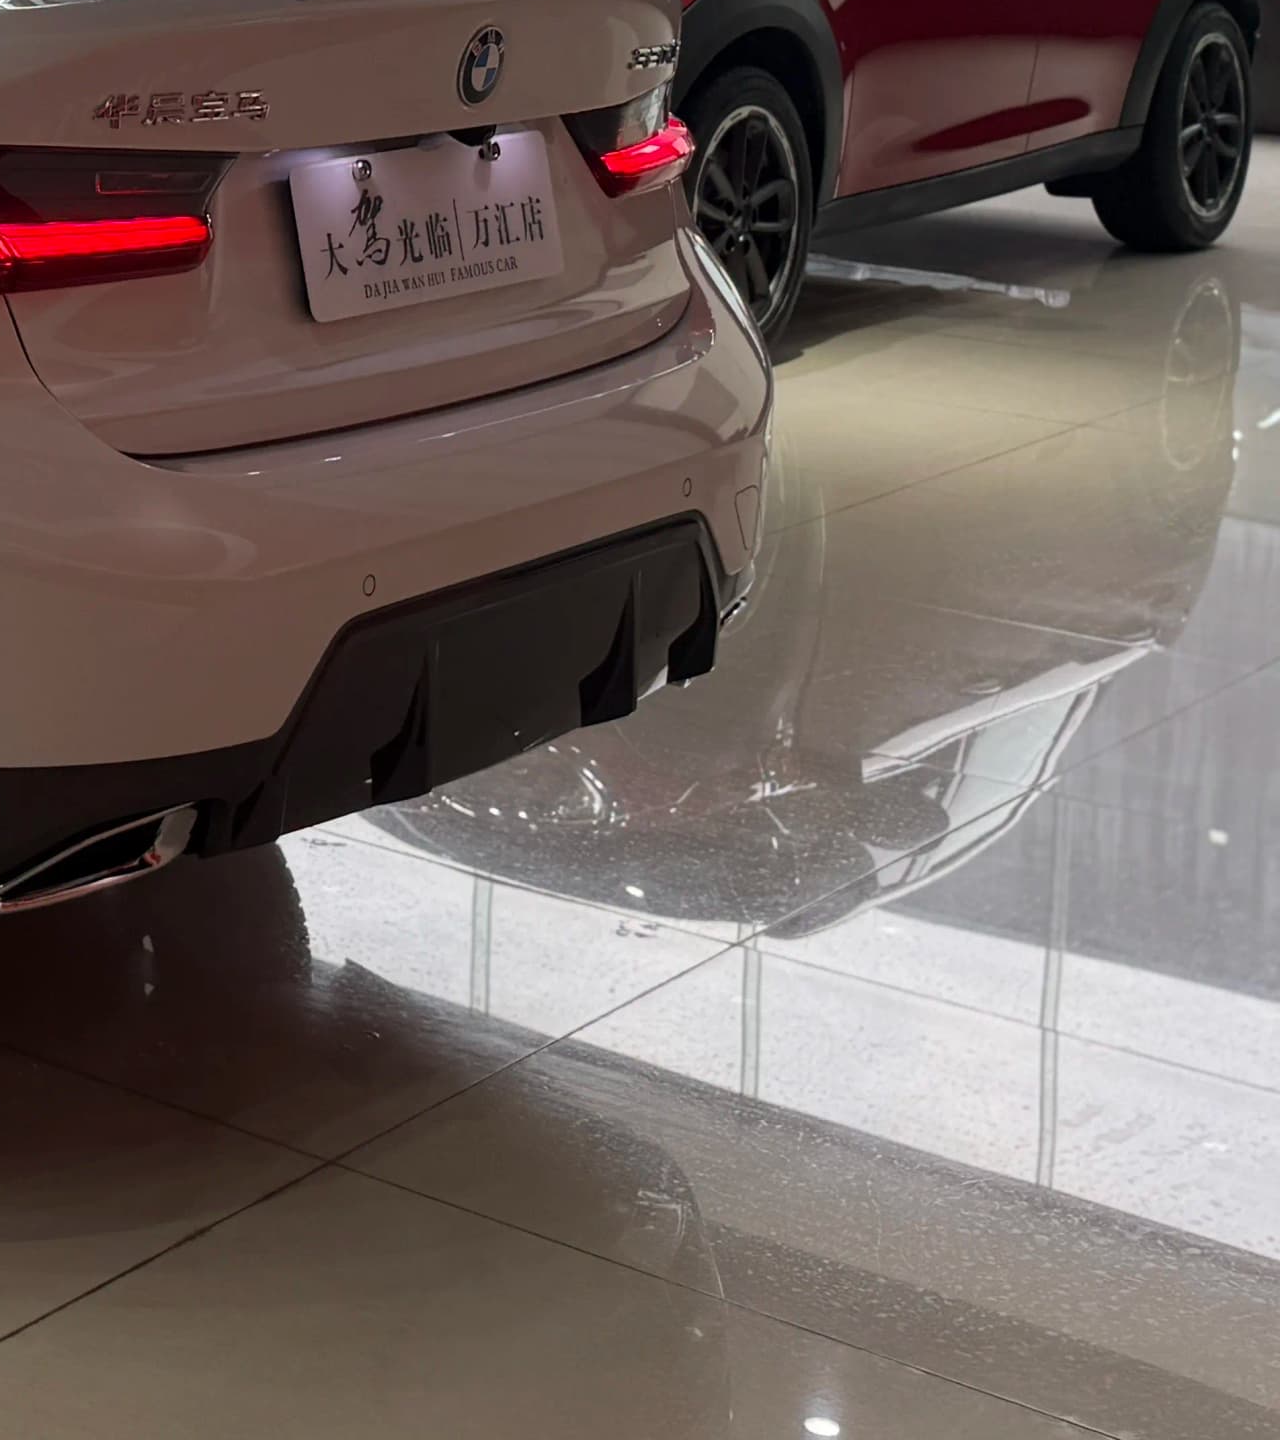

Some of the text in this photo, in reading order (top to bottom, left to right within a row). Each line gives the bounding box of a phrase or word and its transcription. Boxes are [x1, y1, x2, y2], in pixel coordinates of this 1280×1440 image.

[93, 90, 271, 129] 华晨宝马
[364, 283, 381, 299] DA
[383, 278, 401, 300] JIA
[401, 274, 425, 292] WAN
[450, 259, 494, 282] FAMOUS
[495, 255, 519, 273] CAR
